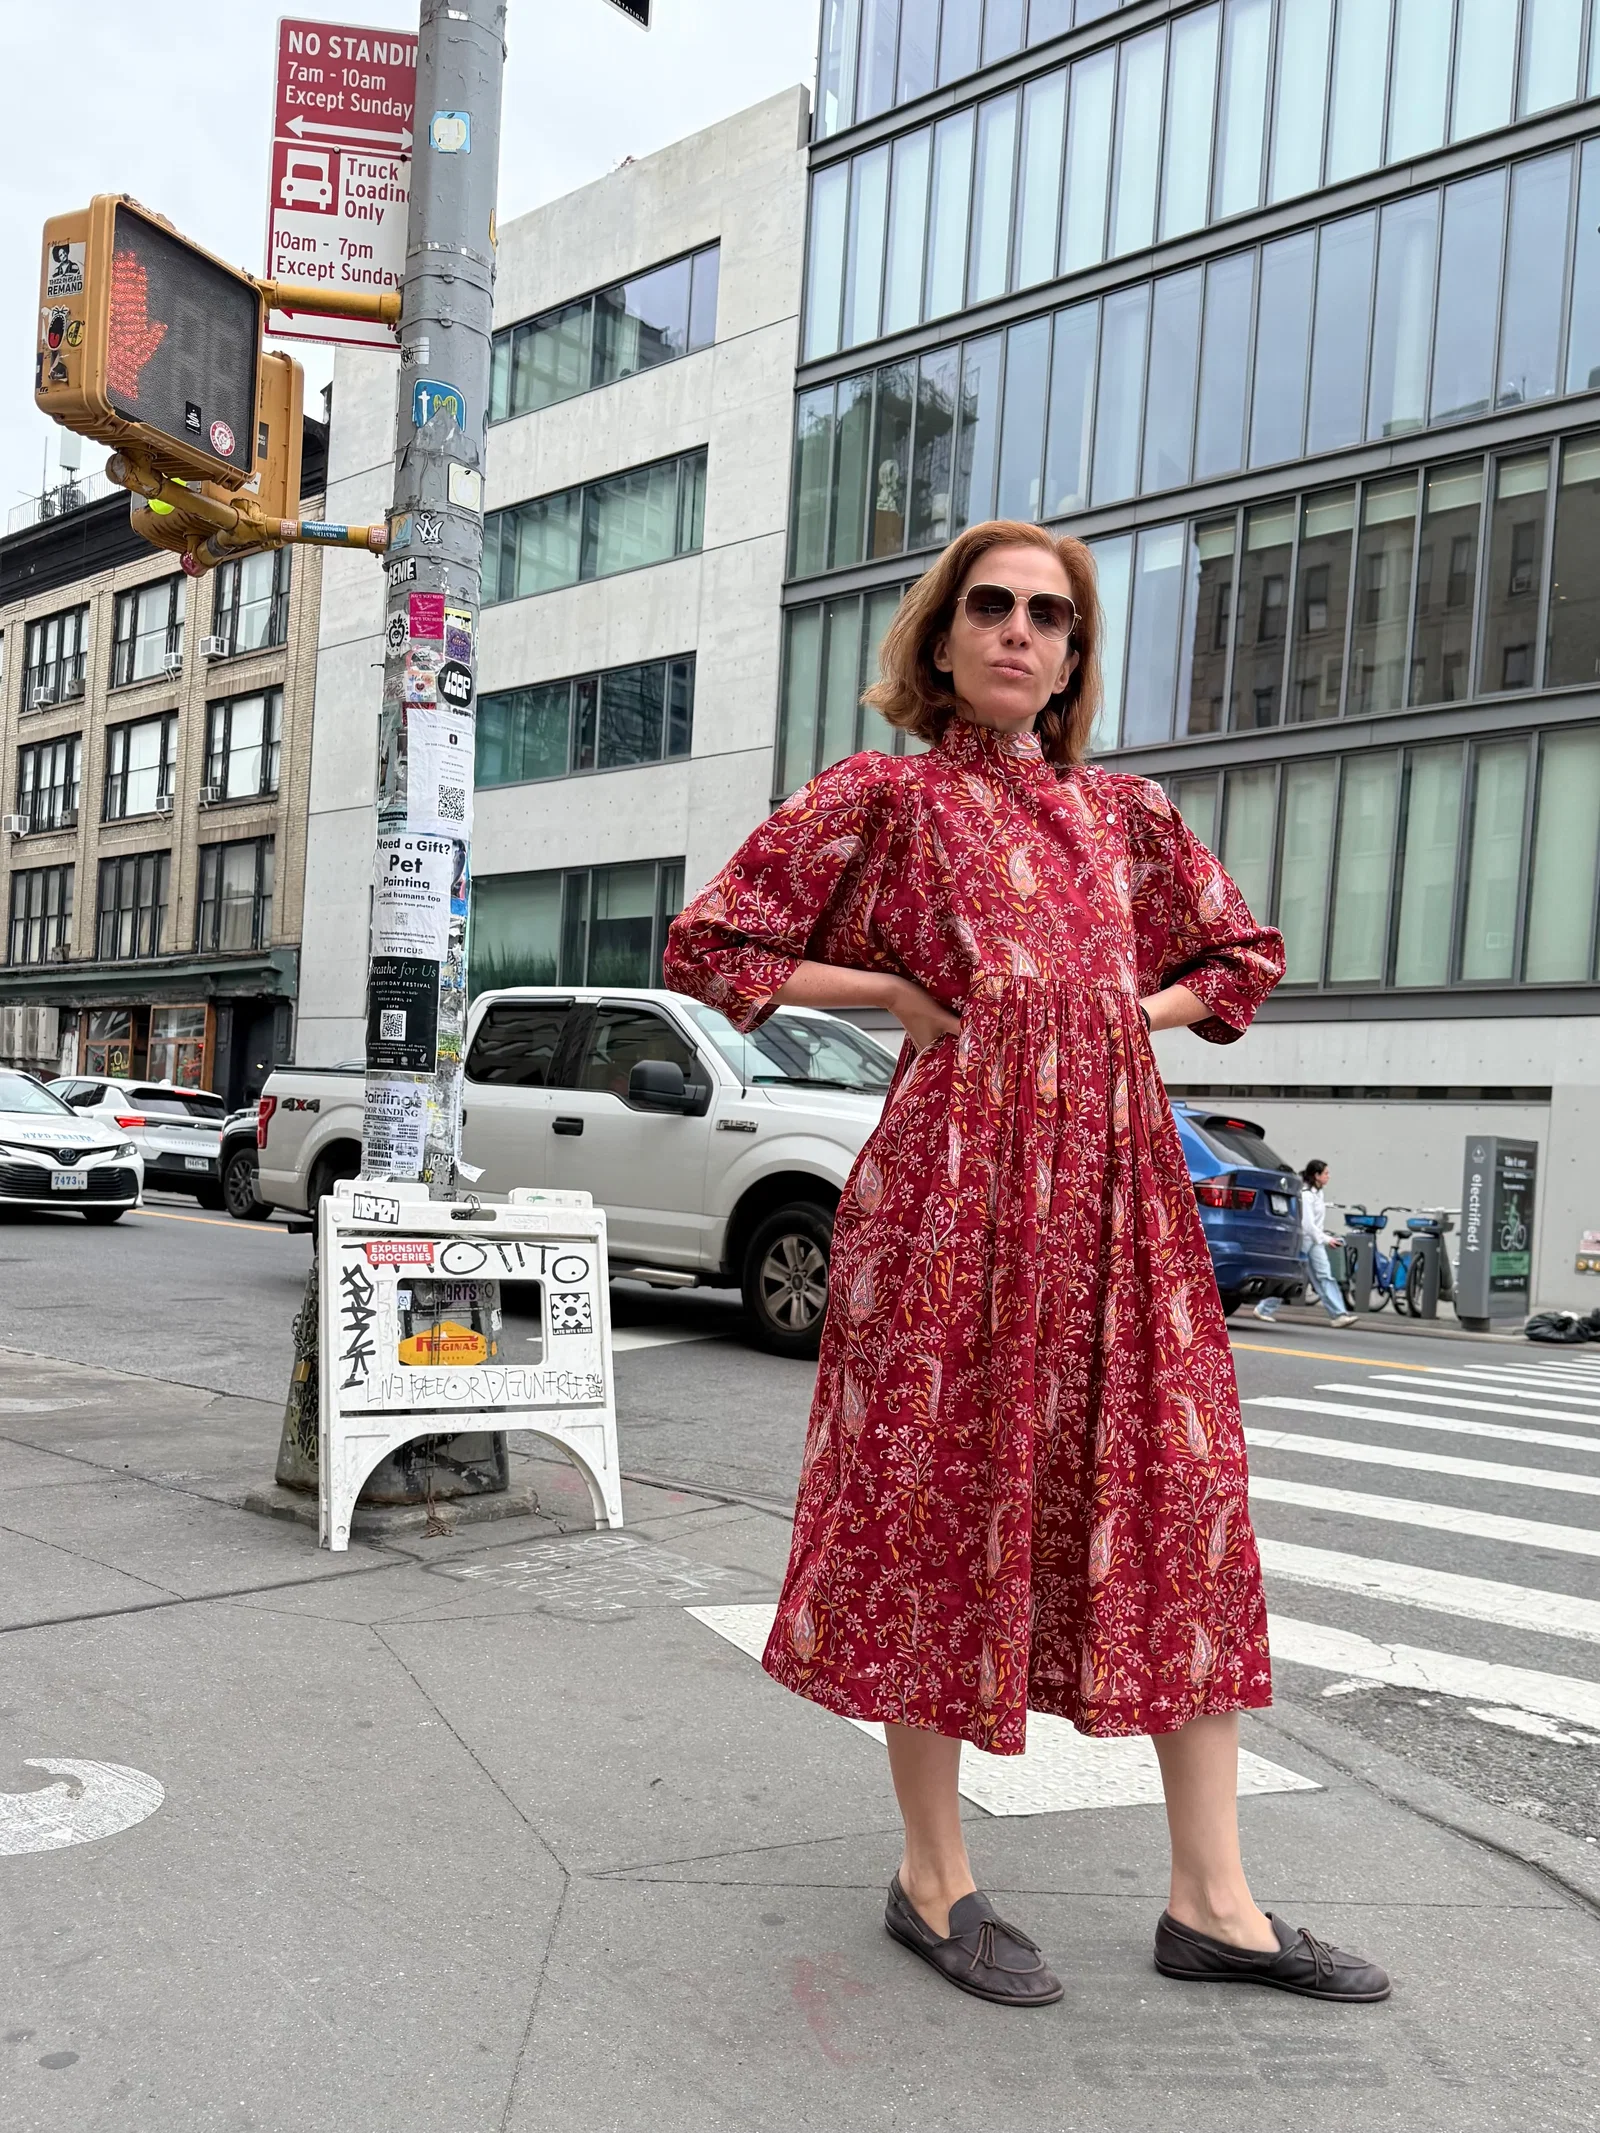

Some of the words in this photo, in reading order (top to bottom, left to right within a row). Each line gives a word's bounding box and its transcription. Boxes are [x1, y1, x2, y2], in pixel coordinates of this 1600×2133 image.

[288, 31, 321, 56] NO
[328, 36, 418, 67] STANDI
[287, 61, 324, 84] 7am
[341, 68, 386, 91] 10am
[286, 85, 345, 112] Except
[350, 93, 413, 121] Sunday
[347, 158, 399, 181] Truck
[344, 200, 385, 225] Only
[274, 231, 317, 252] 10am
[338, 238, 373, 260] 7pm
[276, 256, 336, 281] Except
[341, 263, 402, 290] Sunday
[47, 281, 83, 296] REMAND
[377, 838, 401, 850] Need
[404, 842, 413, 850] a
[416, 840, 451, 855] Gift?
[389, 854, 423, 873] Pet
[383, 875, 430, 890] Painting
[393, 891, 425, 901] humans
[384, 945, 423, 955] LEVITICUS
[398, 961, 418, 979] for
[421, 964, 436, 978] Us
[402, 981, 431, 989] FESTIVAL
[378, 1107, 419, 1117] SANDING
[54, 1175, 77, 1186] 7473
[1467, 1174, 1483, 1244] electrified
[371, 1244, 429, 1253] EXPENSIVE
[369, 1253, 431, 1262] GROCERIES
[416, 1335, 479, 1352] REGINAS
